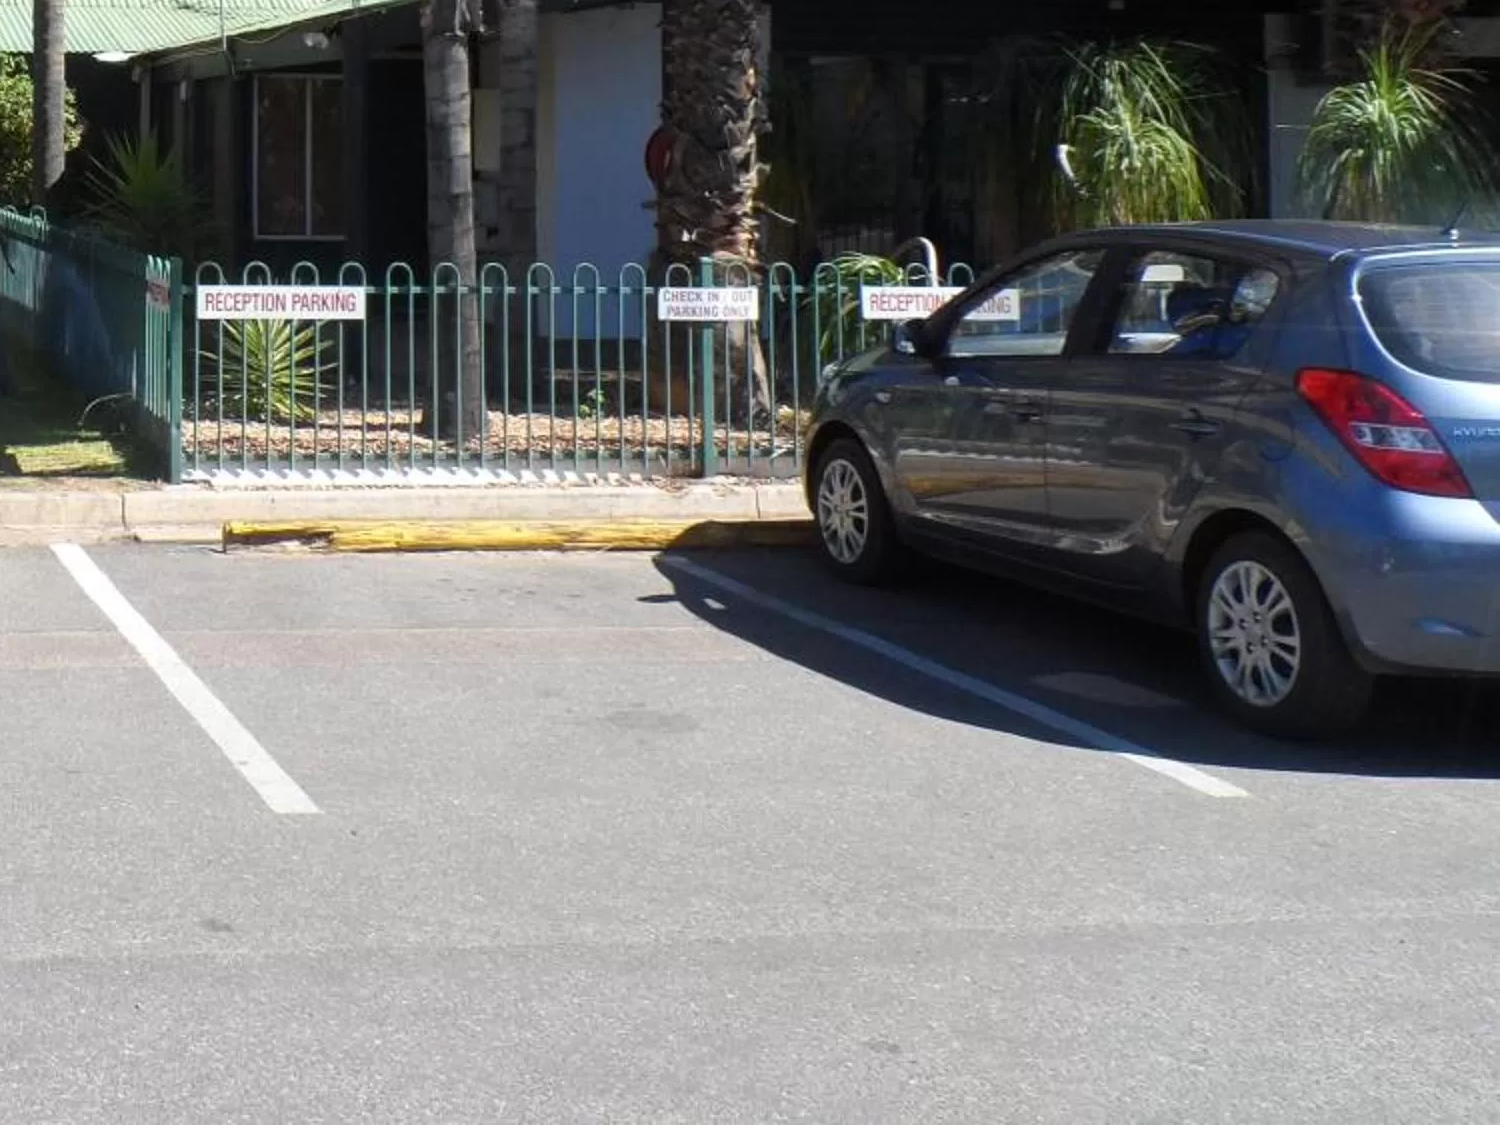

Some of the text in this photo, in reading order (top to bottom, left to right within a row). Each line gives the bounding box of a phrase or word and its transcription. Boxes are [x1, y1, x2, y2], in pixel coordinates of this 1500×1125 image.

[205, 292, 357, 312] RECEPTION PARKING
[663, 290, 702, 302] CHECK
[667, 306, 751, 317] PARKING ONLY
